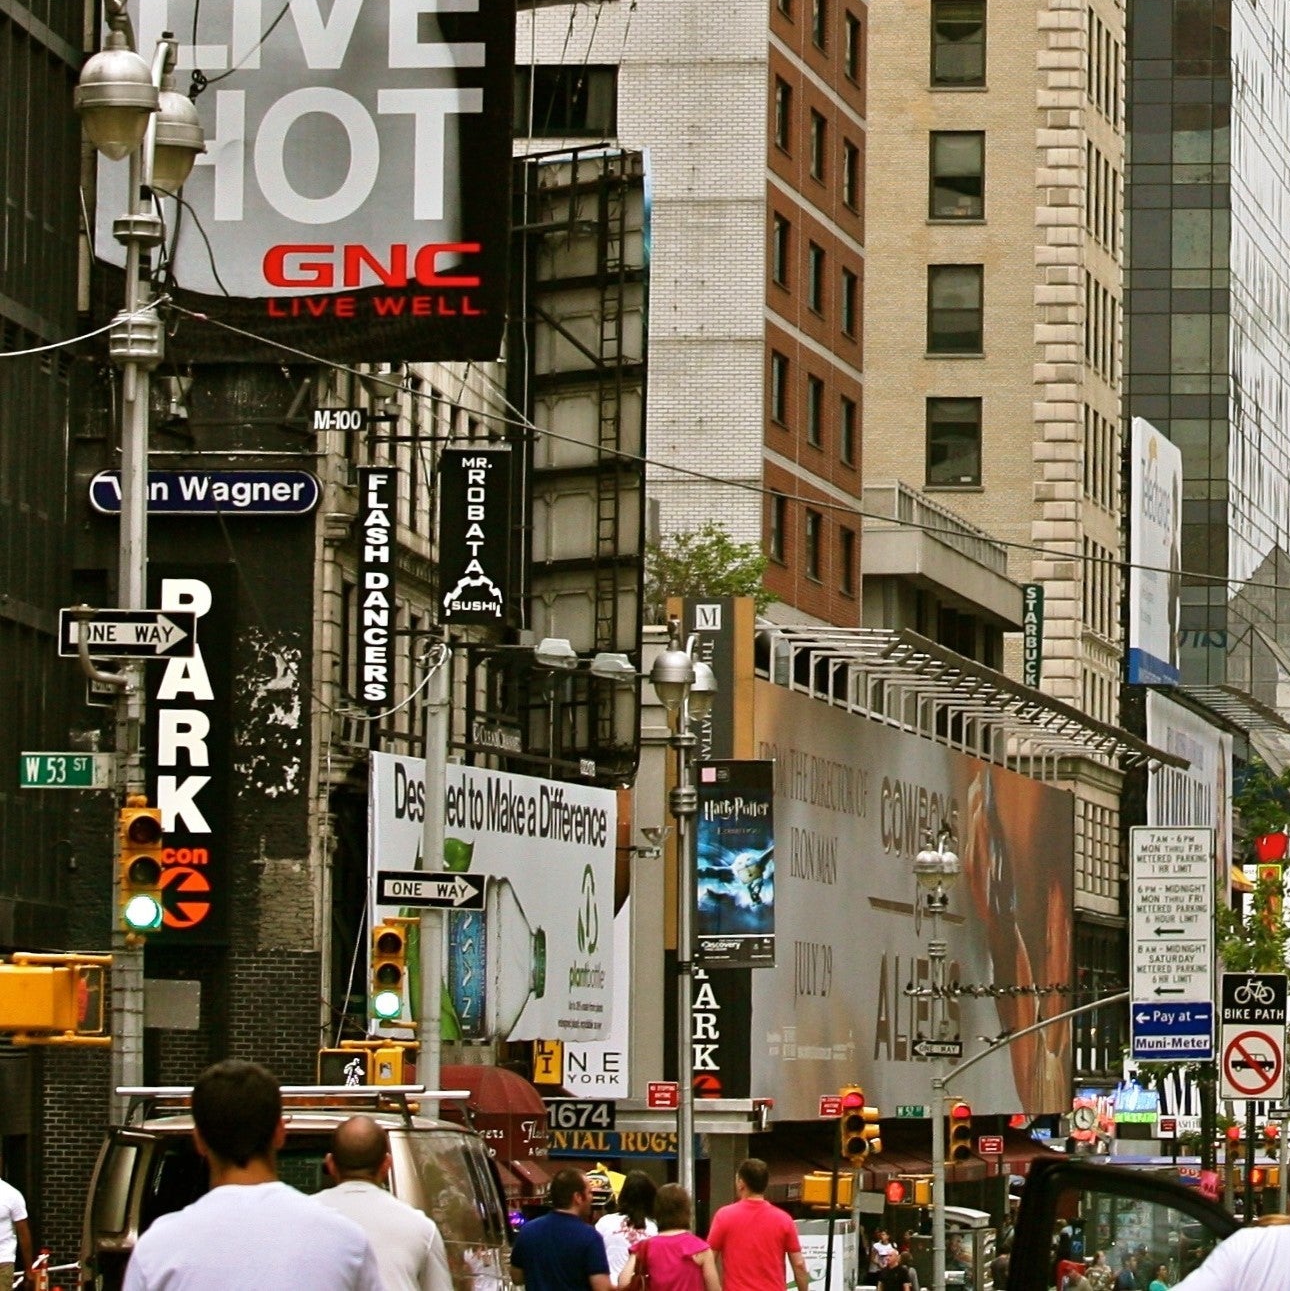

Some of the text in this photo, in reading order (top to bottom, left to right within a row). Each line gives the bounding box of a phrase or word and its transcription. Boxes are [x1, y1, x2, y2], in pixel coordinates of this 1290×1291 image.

[262, 242, 481, 288] GNC
[267, 295, 481, 318] LIVE WELL
[314, 410, 362, 431] M-100
[462, 457, 493, 469] MR.
[179, 476, 305, 508] Wagner
[363, 474, 389, 564] FLASH
[465, 469, 486, 576] ROBATA
[451, 601, 498, 612] SUSHI
[87, 624, 176, 643] NE WAY
[363, 572, 389, 702] DANCERS
[1024, 586, 1038, 686] STARBUCK
[156, 578, 215, 834] PARK
[26, 756, 89, 783] W 53 ST
[393, 762, 608, 849] Desed to Make a Difference
[391, 880, 471, 900] ONE WAY
[1148, 954, 1196, 964] SATURDAY
[1152, 1010, 1191, 1025] Pay at
[1223, 1008, 1285, 1020] BIKE PATH
[1135, 1037, 1210, 1050] Muni-Meter
[567, 1074, 620, 1085] YORK
[550, 1103, 611, 1128] 1674
[549, 1132, 611, 1152] NTAL
